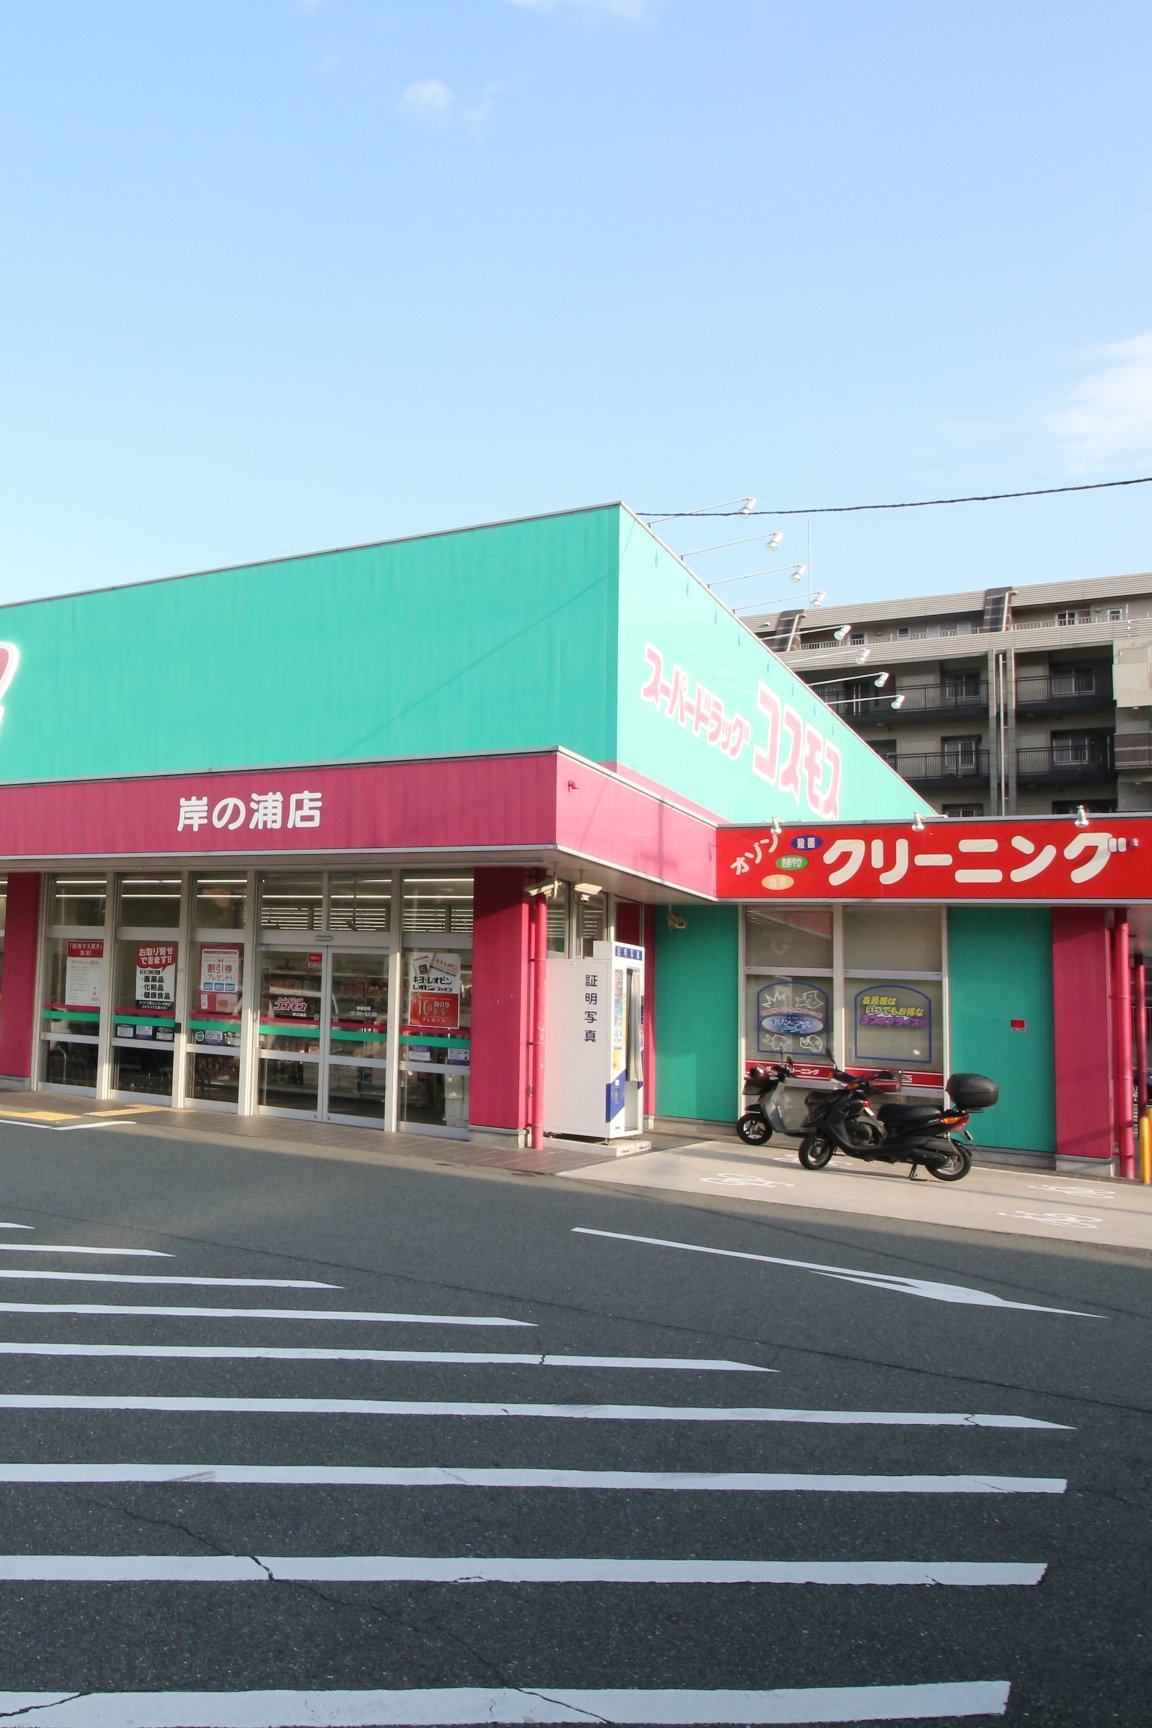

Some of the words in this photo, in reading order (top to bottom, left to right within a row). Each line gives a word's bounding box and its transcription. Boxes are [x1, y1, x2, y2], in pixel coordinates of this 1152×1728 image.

[640, 642, 750, 760] スーパードラッグ
[752, 680, 842, 821] コスモス
[177, 790, 323, 832] 岸の浦店
[730, 828, 779, 876] オゾン
[822, 832, 1127, 887] クリーニング
[138, 946, 174, 956] お取り寄せ
[207, 963, 233, 974] 割引券
[584, 974, 598, 1043] 証明写真
